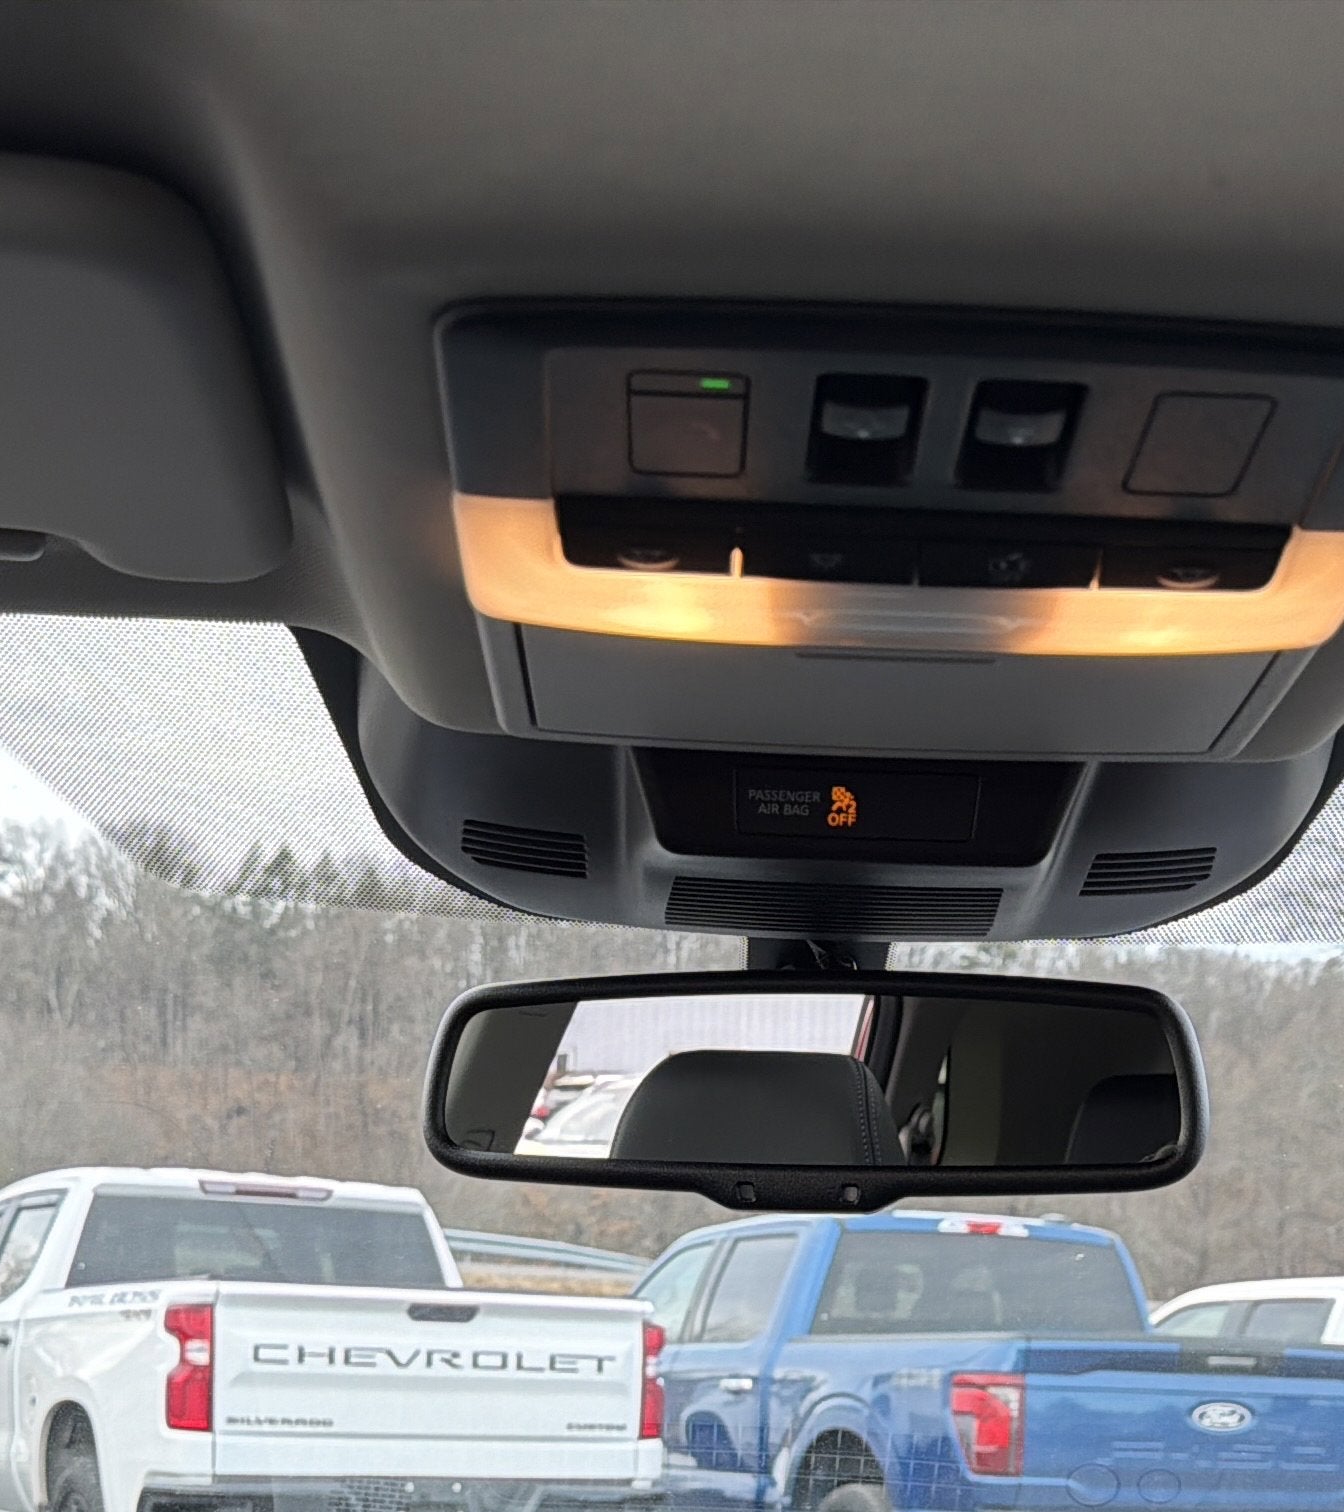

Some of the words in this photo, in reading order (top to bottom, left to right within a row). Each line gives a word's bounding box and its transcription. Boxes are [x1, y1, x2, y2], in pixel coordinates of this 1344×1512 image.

[747, 789, 822, 804] PASSENGER
[757, 802, 782, 816] AIR
[782, 803, 811, 817] BAG
[826, 811, 858, 828] OFF
[252, 1343, 617, 1374] CHEVROLET
